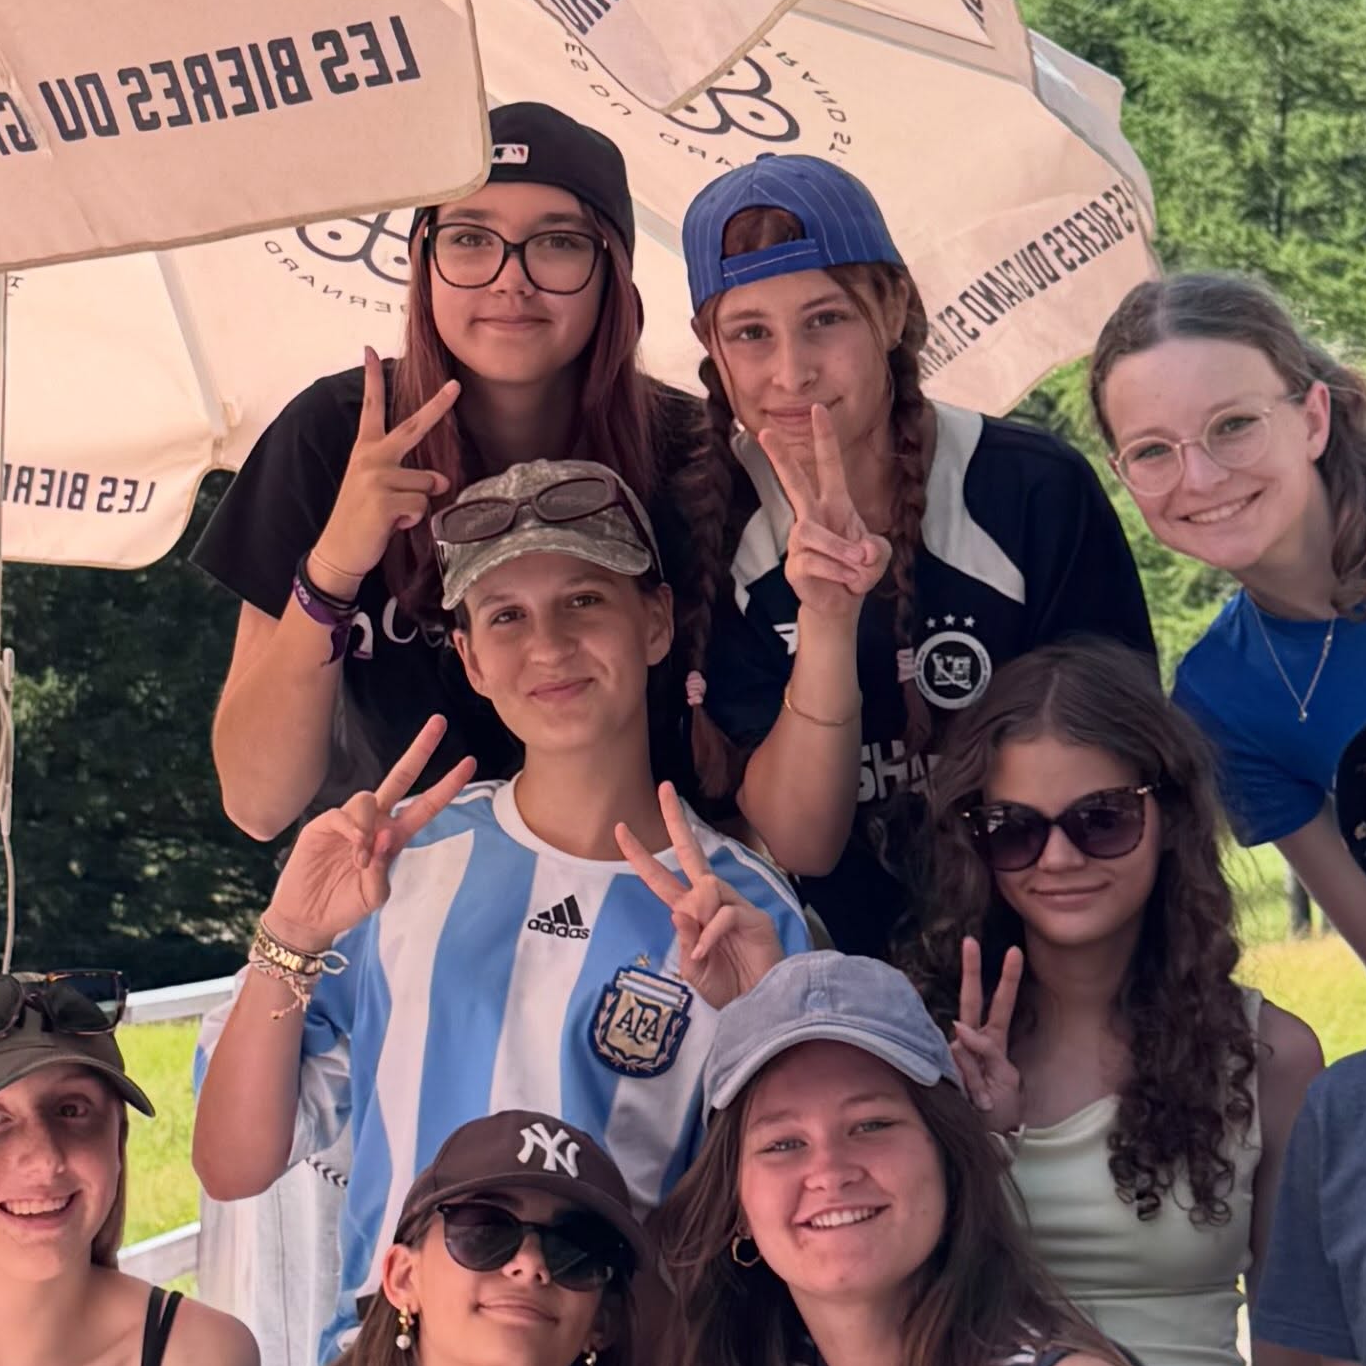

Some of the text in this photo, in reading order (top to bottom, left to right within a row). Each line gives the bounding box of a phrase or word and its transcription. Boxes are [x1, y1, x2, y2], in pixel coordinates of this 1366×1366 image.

[527, 917, 591, 940] adidas
[615, 996, 662, 1045] AFA
[516, 1122, 581, 1179] NY
